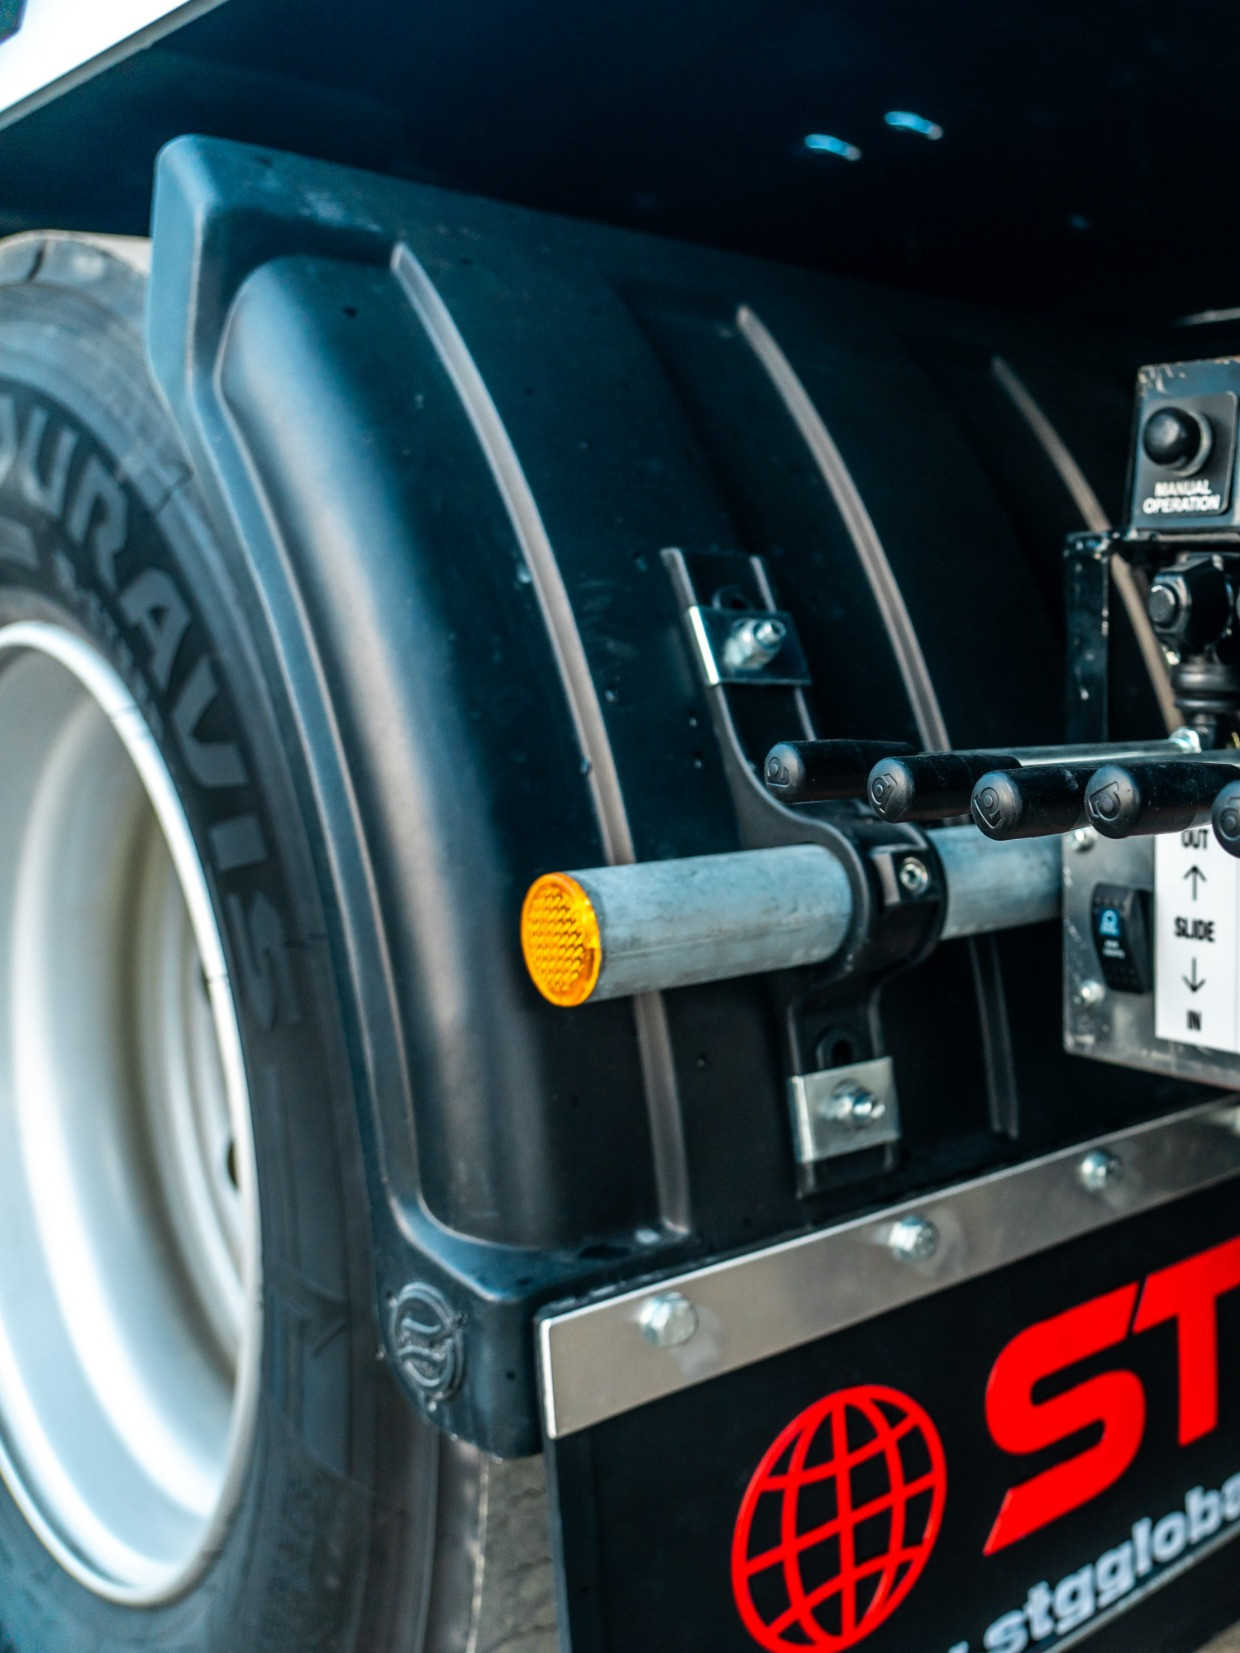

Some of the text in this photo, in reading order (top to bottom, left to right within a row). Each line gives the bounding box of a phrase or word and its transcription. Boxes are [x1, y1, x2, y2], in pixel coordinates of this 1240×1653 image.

[1154, 480, 1212, 496] MANUAL
[1143, 495, 1220, 514] OPERATION
[1181, 829, 1208, 849] OUT
[1175, 916, 1215, 943] SLIDE
[1186, 1010, 1202, 1031] IN
